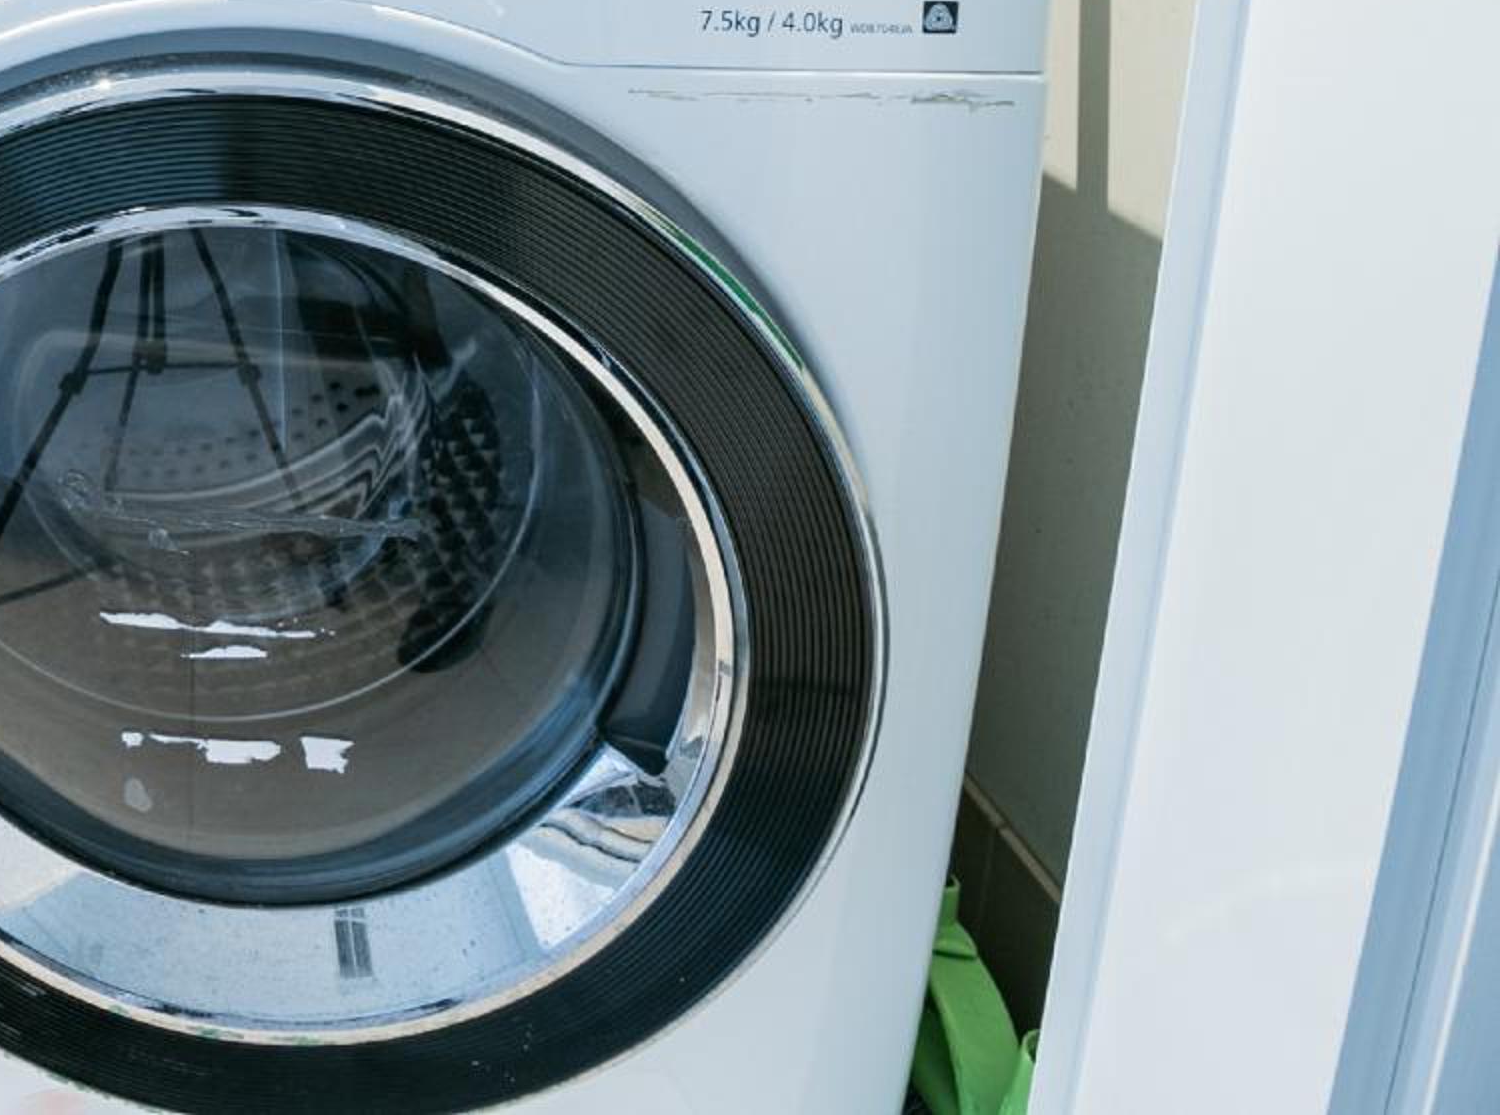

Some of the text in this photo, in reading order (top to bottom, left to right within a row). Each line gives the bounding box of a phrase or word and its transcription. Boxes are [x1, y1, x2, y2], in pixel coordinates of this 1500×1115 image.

[700, 11, 843, 39] 7.5kg / 4.0kg
